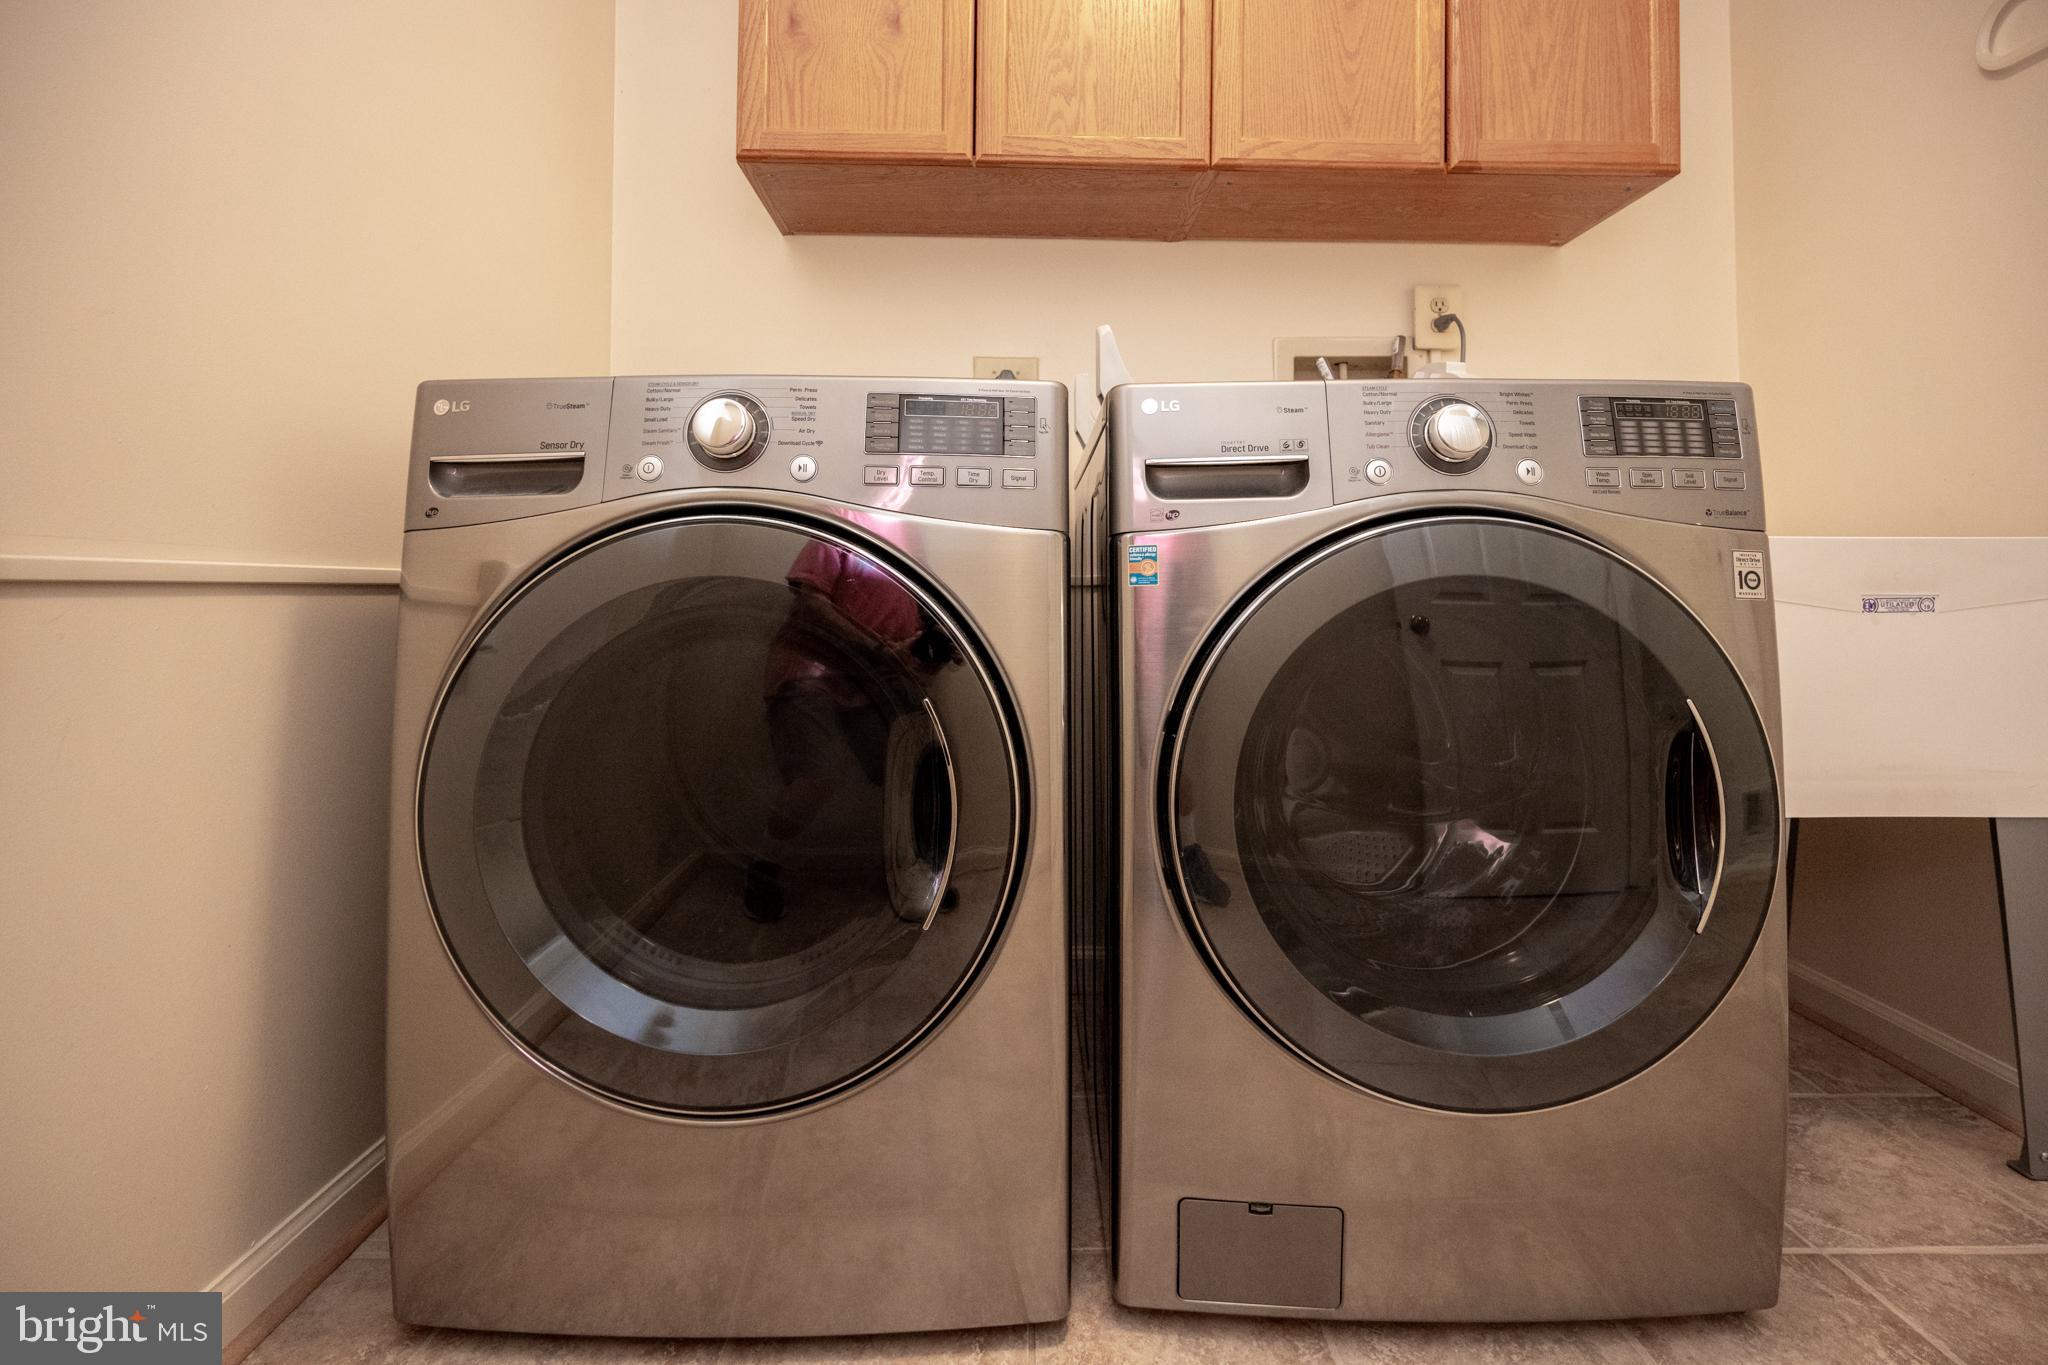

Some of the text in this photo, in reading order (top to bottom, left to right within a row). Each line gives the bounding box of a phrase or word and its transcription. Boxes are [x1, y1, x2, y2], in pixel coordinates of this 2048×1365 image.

[452, 400, 470, 412] LG
[1161, 400, 1180, 412] LG
[540, 440, 584, 450] Sensor Dry
[1738, 570, 1761, 590] 10
